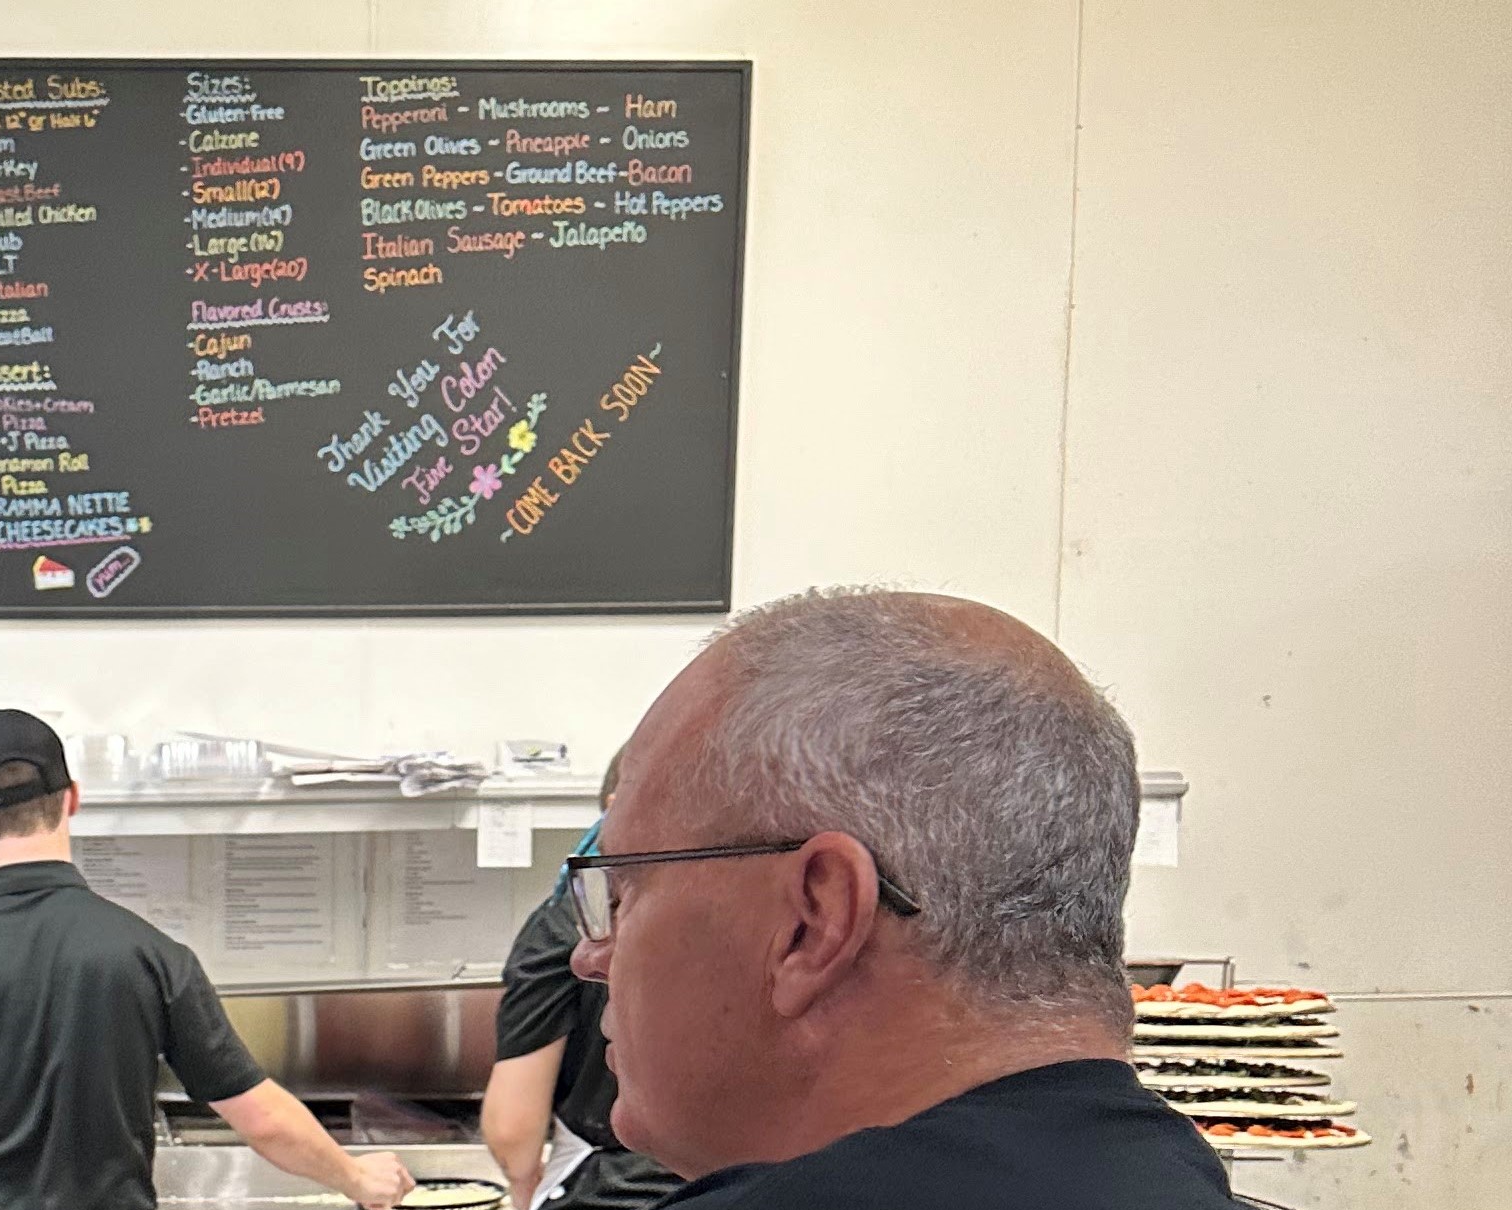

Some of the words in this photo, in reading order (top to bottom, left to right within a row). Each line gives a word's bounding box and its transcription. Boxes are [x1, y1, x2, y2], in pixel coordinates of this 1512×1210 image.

[187, 72, 252, 98] Sizes:
[28, 114, 46, 131] or
[361, 103, 449, 133] Pepperoni
[478, 97, 591, 120] Mushrooms
[624, 92, 678, 119] Ham
[188, 129, 261, 154] Calzone
[359, 137, 417, 162] Green
[424, 134, 482, 156] Olives
[505, 128, 591, 157] Pineapple
[621, 124, 690, 150] Onions
[360, 165, 415, 190] Green
[421, 164, 491, 190] Peppers
[505, 161, 573, 185] Ground
[574, 159, 618, 185] Beef
[627, 157, 693, 187] Bacon
[22, 183, 62, 200] Beef
[38, 203, 97, 224] Chicken
[360, 197, 414, 227] Black
[414, 197, 468, 221] Olives
[486, 192, 586, 217] Tomatoes
[613, 190, 649, 216] Hot
[651, 190, 725, 221] Peppers
[361, 232, 435, 260] Italian
[447, 225, 526, 260] Sausage
[363, 262, 444, 295] Spinach
[191, 298, 264, 322] Flavored
[194, 332, 253, 359] Cajun
[196, 357, 255, 381] Ranch
[316, 408, 391, 474] Thank
[387, 358, 441, 409] You
[432, 308, 481, 356] For
[1, 413, 47, 432] Pizza
[197, 405, 265, 428] Pretzel
[346, 413, 450, 493] Visiting
[440, 347, 508, 413] Colon
[24, 431, 70, 451] Pizza
[400, 455, 454, 506] Five
[451, 385, 518, 456] Star!
[547, 417, 612, 486] BACK
[58, 451, 90, 473] Roll
[0, 474, 49, 496] Pizza
